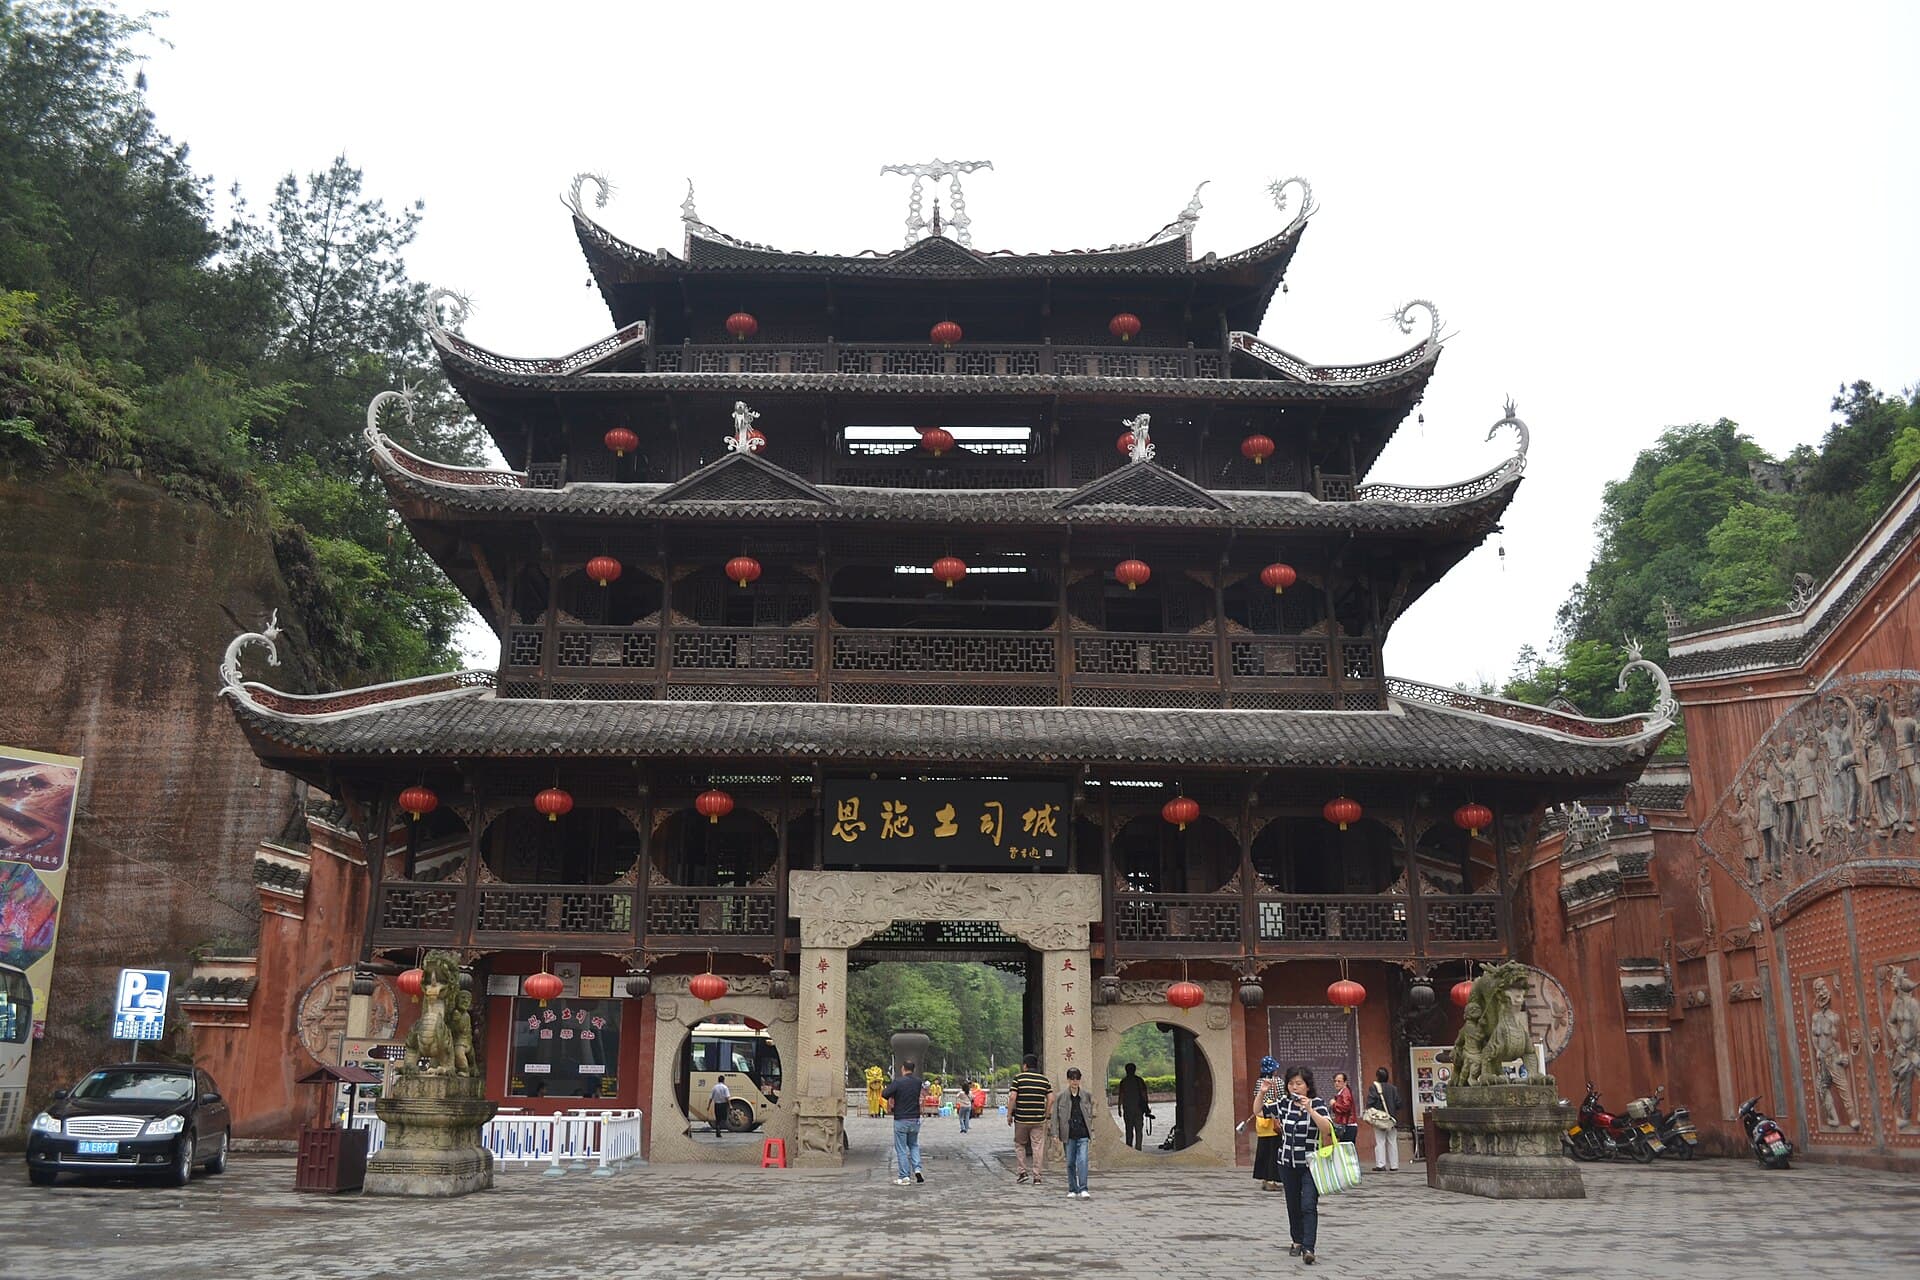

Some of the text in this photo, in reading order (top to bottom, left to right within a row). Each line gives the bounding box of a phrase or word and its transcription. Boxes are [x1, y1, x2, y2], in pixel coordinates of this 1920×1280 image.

[832, 797, 1060, 846] 恩施土司城
[122, 973, 147, 1008] P
